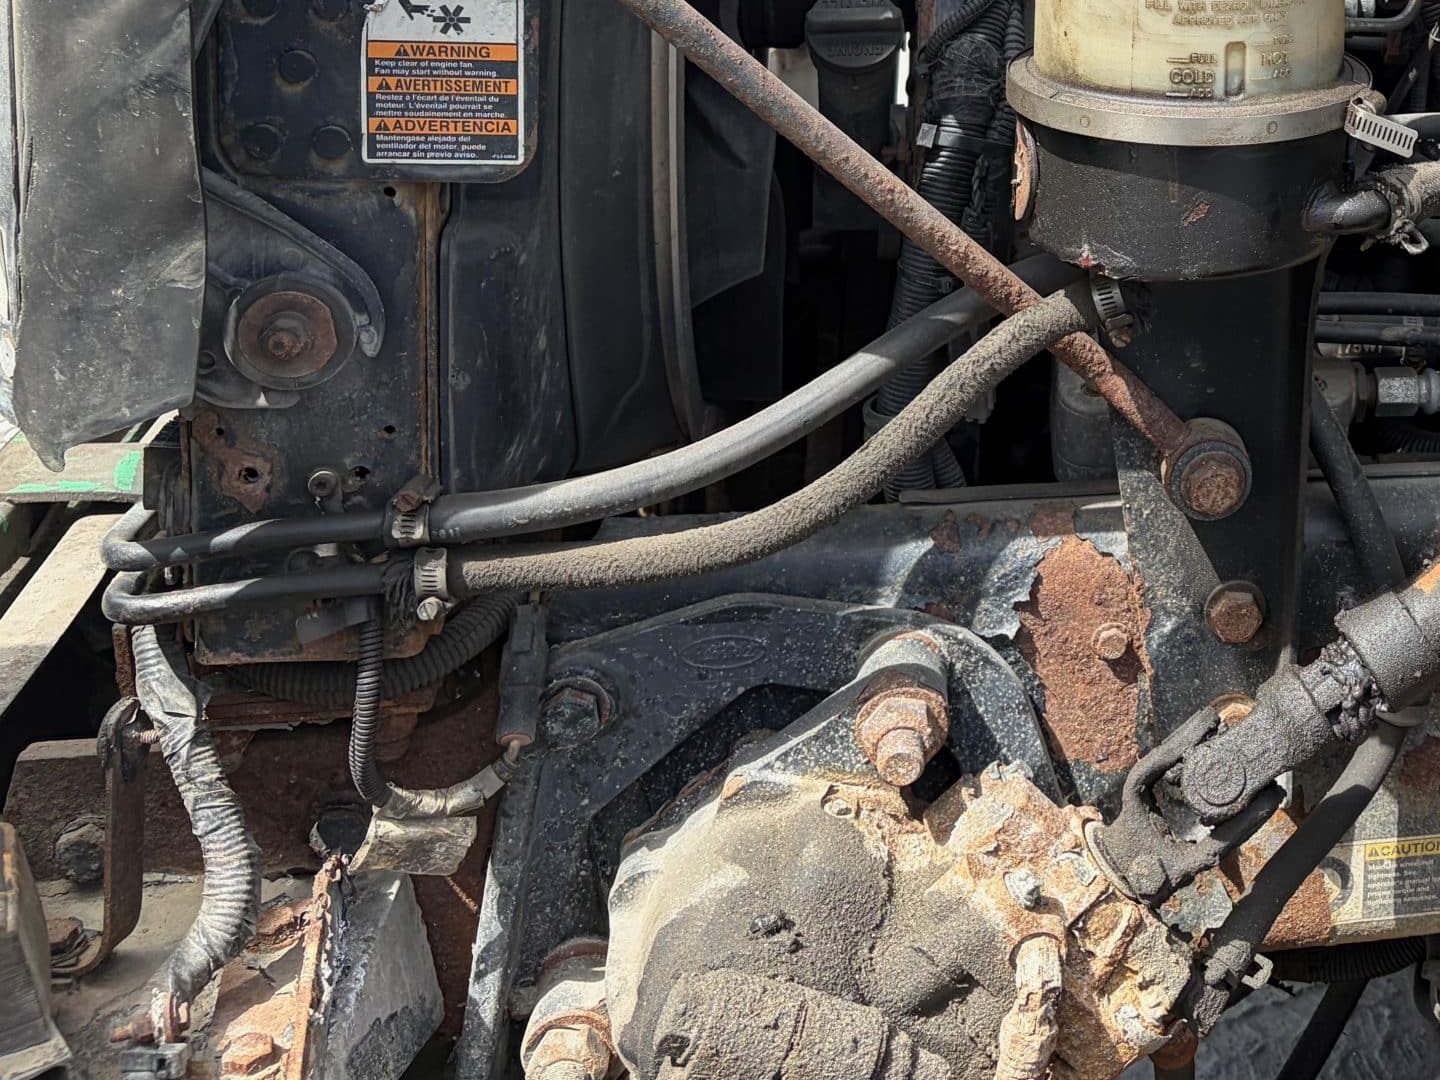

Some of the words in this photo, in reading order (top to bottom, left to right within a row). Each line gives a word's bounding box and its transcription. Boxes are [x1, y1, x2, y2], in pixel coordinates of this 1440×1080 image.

[410, 44, 491, 59] WARNING
[375, 60, 396, 68] Keep
[430, 61, 458, 69] engine
[432, 68, 463, 76] without
[464, 70, 498, 78] warning.
[1169, 67, 1215, 84] COLD
[395, 79, 511, 93] AVERTISSEMENT
[449, 103, 485, 111] pourrait
[404, 110, 461, 118] soudainement
[393, 119, 512, 133] ADVERTENCIA
[376, 134, 426, 143] Mantengase
[427, 135, 457, 143] alejado
[461, 143, 487, 151] puede
[412, 150, 425, 158] sin
[427, 151, 452, 159] previo
